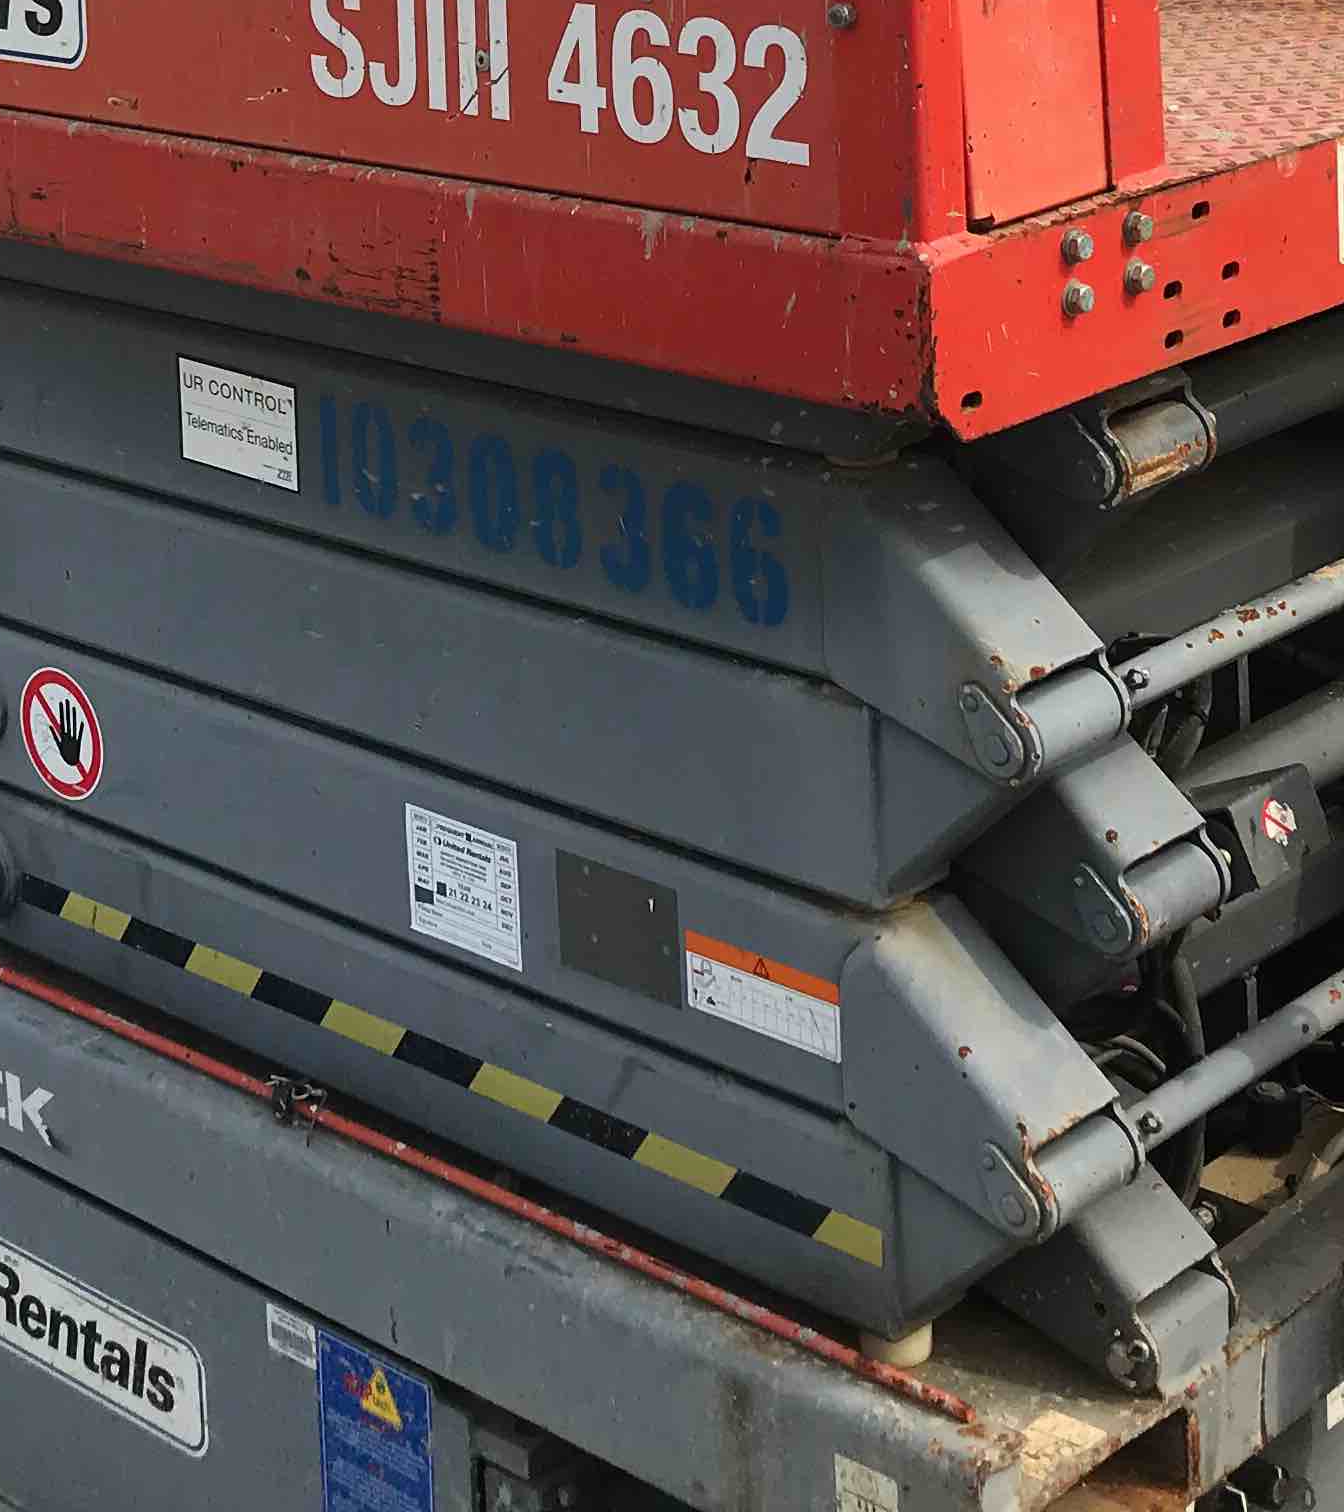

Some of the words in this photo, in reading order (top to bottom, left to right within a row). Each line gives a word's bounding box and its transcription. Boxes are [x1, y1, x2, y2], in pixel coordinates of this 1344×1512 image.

[547, 2, 811, 167] 4632
[183, 372, 204, 393] UR
[184, 410, 244, 442] Telematics
[246, 428, 293, 456] Enabled
[318, 392, 790, 627] 10308366
[442, 839, 466, 854] United
[466, 848, 491, 864] Rentals
[448, 888, 457, 898] 21
[459, 891, 469, 903] 22
[482, 900, 492, 911] 24
